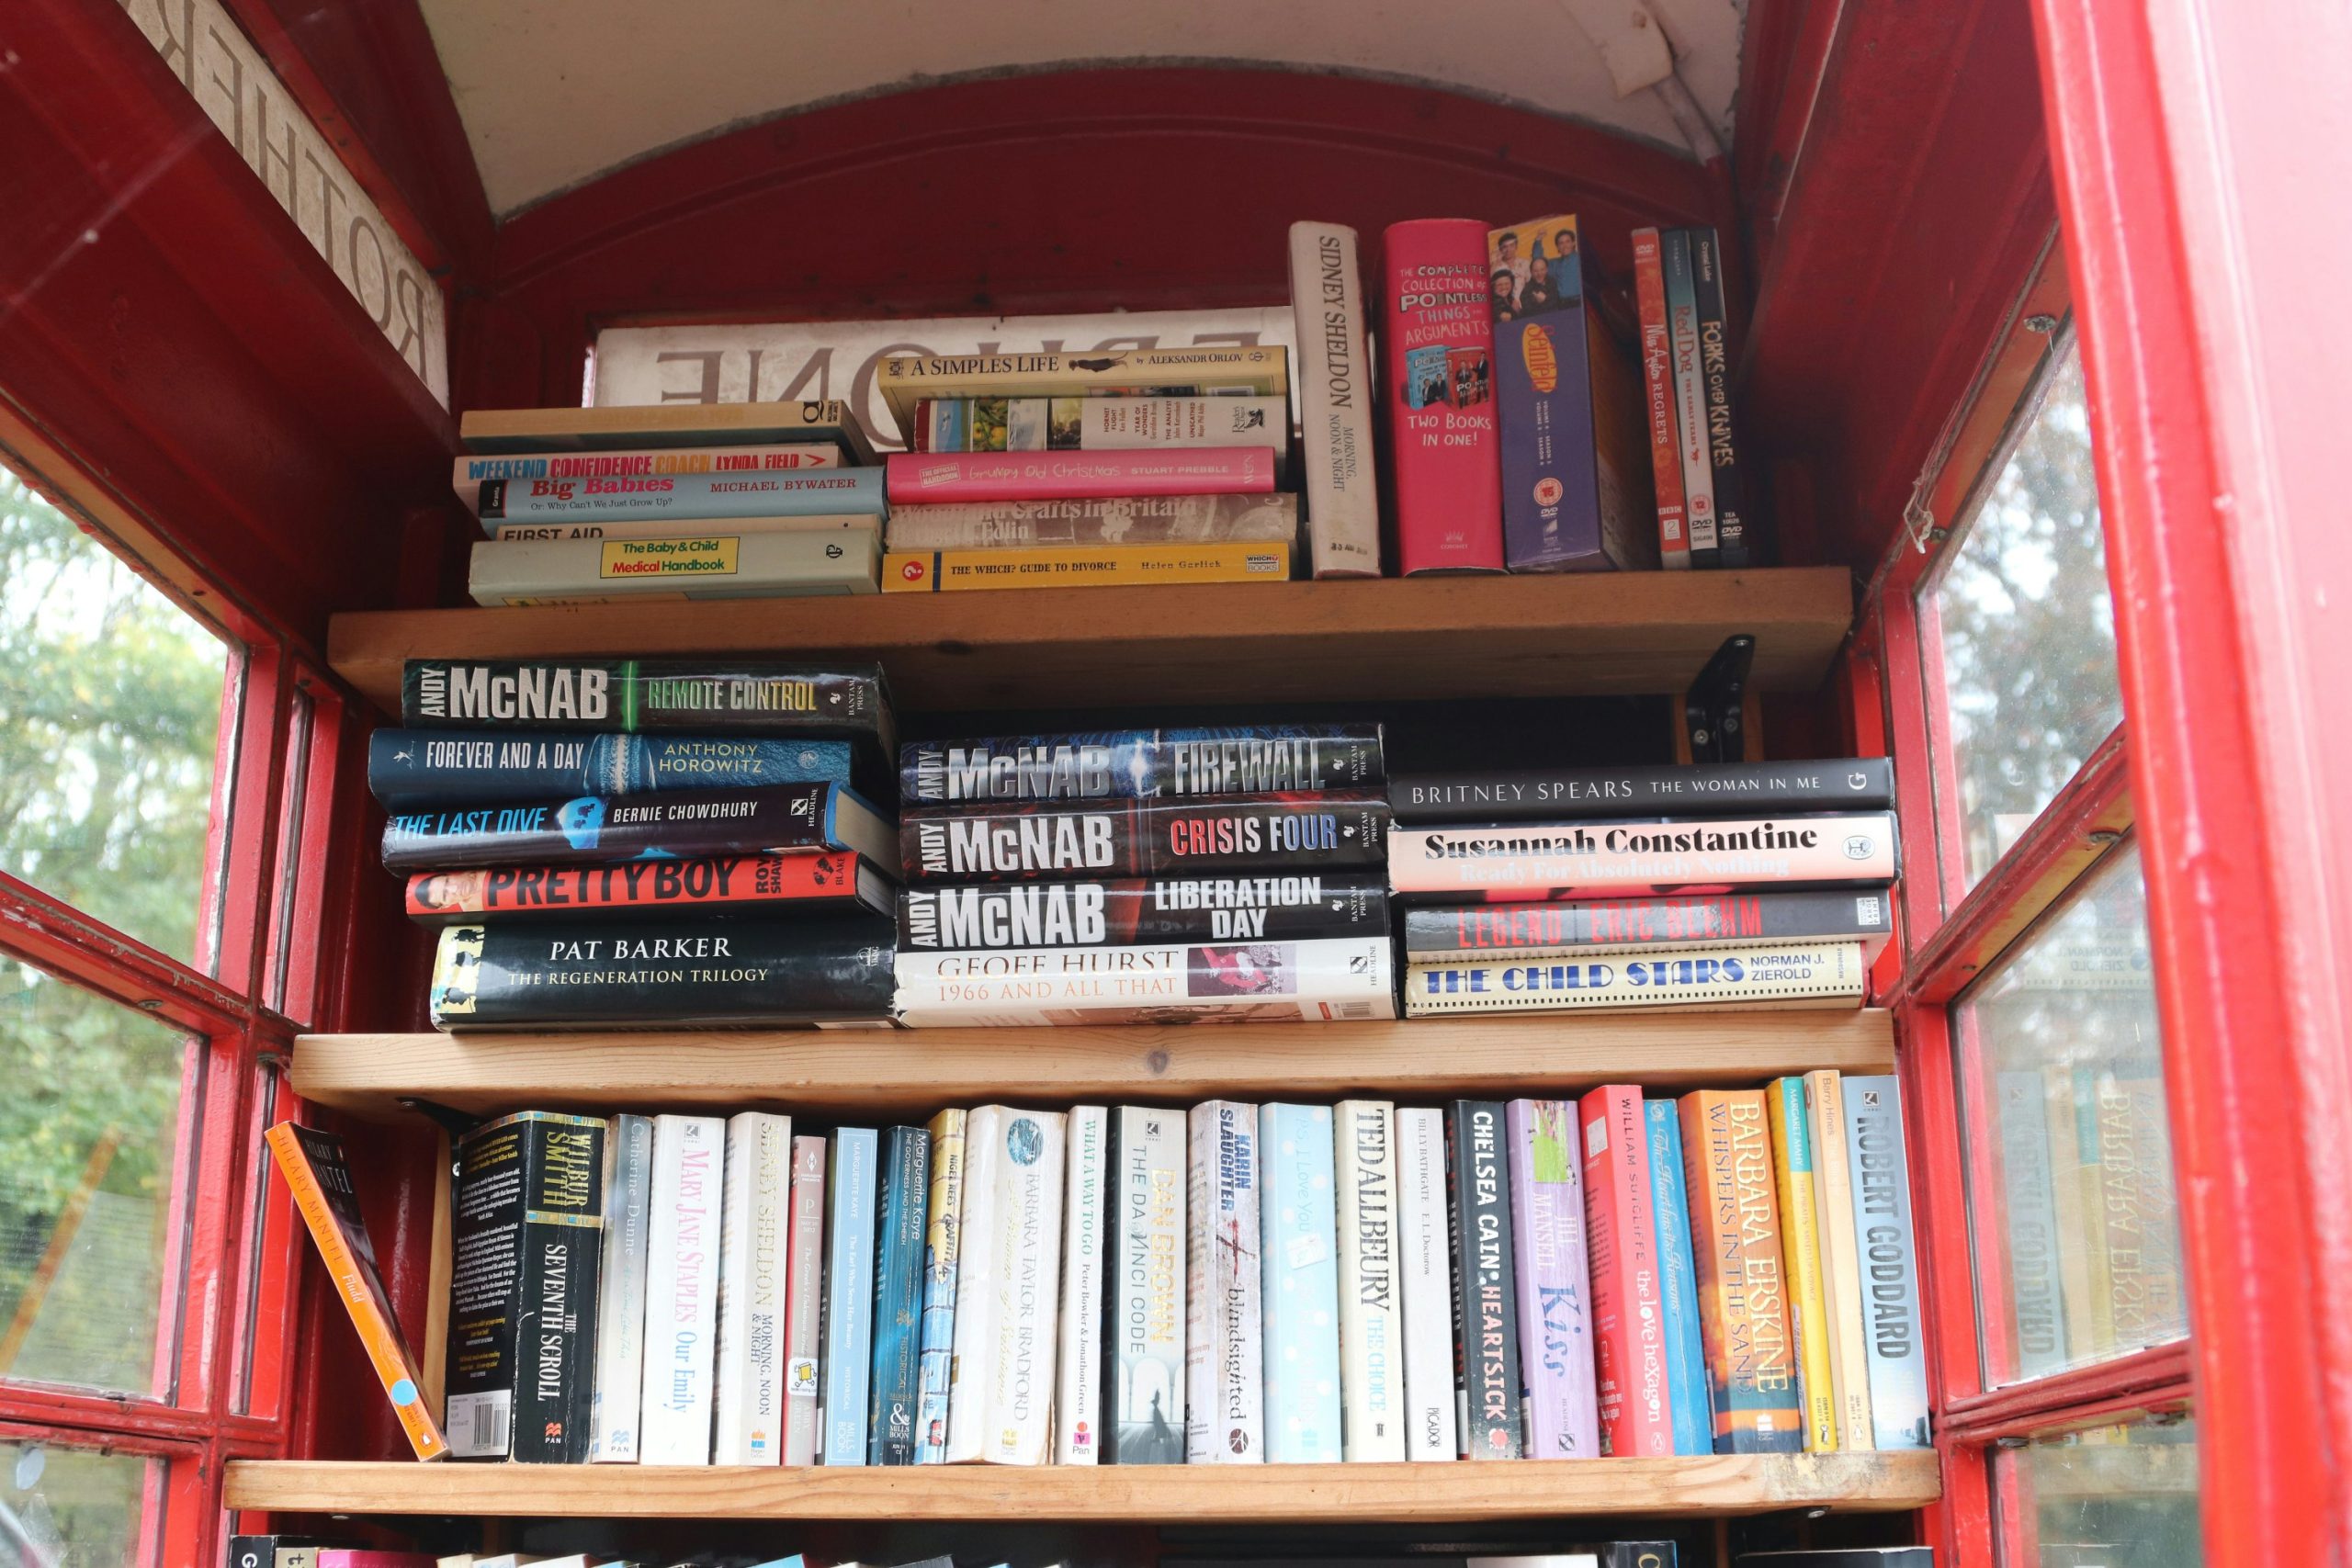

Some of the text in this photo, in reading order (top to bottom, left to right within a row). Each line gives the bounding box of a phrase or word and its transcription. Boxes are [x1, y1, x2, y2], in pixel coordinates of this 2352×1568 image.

[1318, 235, 1351, 410] SIDNEY SHELDON
[1406, 321, 1489, 345] ARGUMENTS
[1417, 306, 1471, 324] THINGS
[1675, 306, 1694, 374] Red Dog
[910, 352, 1243, 376] A SIMPLES LIFE by ALEKSANDR ORLOV
[1702, 321, 1735, 468] FORKS OVER KNIVES
[1408, 413, 1492, 430] TWO BOOKS
[1422, 432, 1478, 446] IN ONE!
[469, 458, 548, 480] WEEKEND
[550, 456, 652, 479] CONFIDENCE
[715, 454, 759, 470] LYNDA
[765, 453, 800, 468] FIELD
[530, 476, 857, 500] Big Babies MICHAEL BYWATER
[530, 496, 673, 513] Or: Why Can't We Just Grow Up?
[612, 558, 725, 574] Medical Handbook
[623, 540, 719, 555] The Baby & Child
[951, 566, 972, 575] THE
[975, 564, 1016, 574] WHICH?
[1020, 563, 1052, 573] GUIDE
[1055, 563, 1069, 572] TO
[1071, 561, 1117, 572] DIVORCE
[1141, 561, 1174, 570] Helen
[421, 666, 817, 720] ANDY McNAB REMOTE CONTROL
[426, 741, 585, 770] FOREVER AND A DAY
[658, 757, 763, 774] HOROWITZ
[663, 743, 759, 758] ANTHONY
[919, 739, 1327, 801] ANDY McNAB FIREWALL
[1412, 776, 1821, 806] BRITNEY SPEARS THE WOMAN IN ME
[393, 800, 759, 841] THE LAST DIVE BERNIE CHOWDHURY
[922, 813, 1339, 874] ANDY McNAB CRISIS FOUR
[1424, 822, 1818, 862] Susannah Constantine
[755, 858, 769, 895] ROY
[835, 856, 845, 886] BLAKE
[910, 875, 1321, 949] ANDY McNAB LIBERATION
[1211, 908, 1269, 940] DAY
[1457, 896, 1763, 949] LEGEND ERIC BLEHM
[550, 937, 733, 962] PAT BARKER
[937, 950, 1180, 982] GEOFF HURST
[508, 967, 770, 987] THE REGENERATION TRILOGY
[938, 976, 1178, 1002] 1966 AND ALL THAT
[1422, 955, 1826, 995] THE CHILD STARS NORMAN J.
[1751, 967, 1813, 982] ZIEROLD
[1822, 1077, 1832, 1103] Barry
[1790, 1088, 1804, 1168] MARGARET MAHY
[1825, 1106, 1836, 1135] Hines
[542, 1131, 563, 1206] SMITH
[567, 1134, 592, 1208] WILBUR
[1220, 1109, 1236, 1212] SLAUGHTER
[1234, 1134, 1251, 1190] KARIN
[1472, 1111, 1494, 1206] CHELSEA
[1728, 1100, 1774, 1248] BARBARA
[1857, 1115, 1899, 1215] ROBERT
[911, 1134, 927, 1240] Marguerite Kaye
[277, 1135, 312, 1193] HILARY
[307, 1200, 345, 1264] MANTEL
[342, 1273, 366, 1303] Fludd
[754, 1122, 779, 1307] SIDNEY SHELDON
[1532, 1192, 1555, 1270] MANSELL
[1149, 1168, 1177, 1343] DAN BROWN
[1356, 1109, 1391, 1412] TED ALLBEURY THE CHOICE
[1709, 1102, 1756, 1394] WHISPERS IN THE SAND
[662, 1149, 710, 1413] MARY JANE STAPLES Our Emily
[1866, 1224, 1914, 1359] GODDARD
[537, 1243, 568, 1402] SEVENTH SCROLL
[564, 1314, 577, 1334] THE
[1537, 1282, 1581, 1378] Kiss
[1745, 1255, 1789, 1394] ERSKINE
[1224, 1287, 1247, 1420] blindsighted
[1480, 1285, 1507, 1422] HEARTSICK
[759, 1378, 771, 1416] NOON
[1427, 1406, 1442, 1449] PICADOR
[1072, 1445, 1091, 1456] Pan
